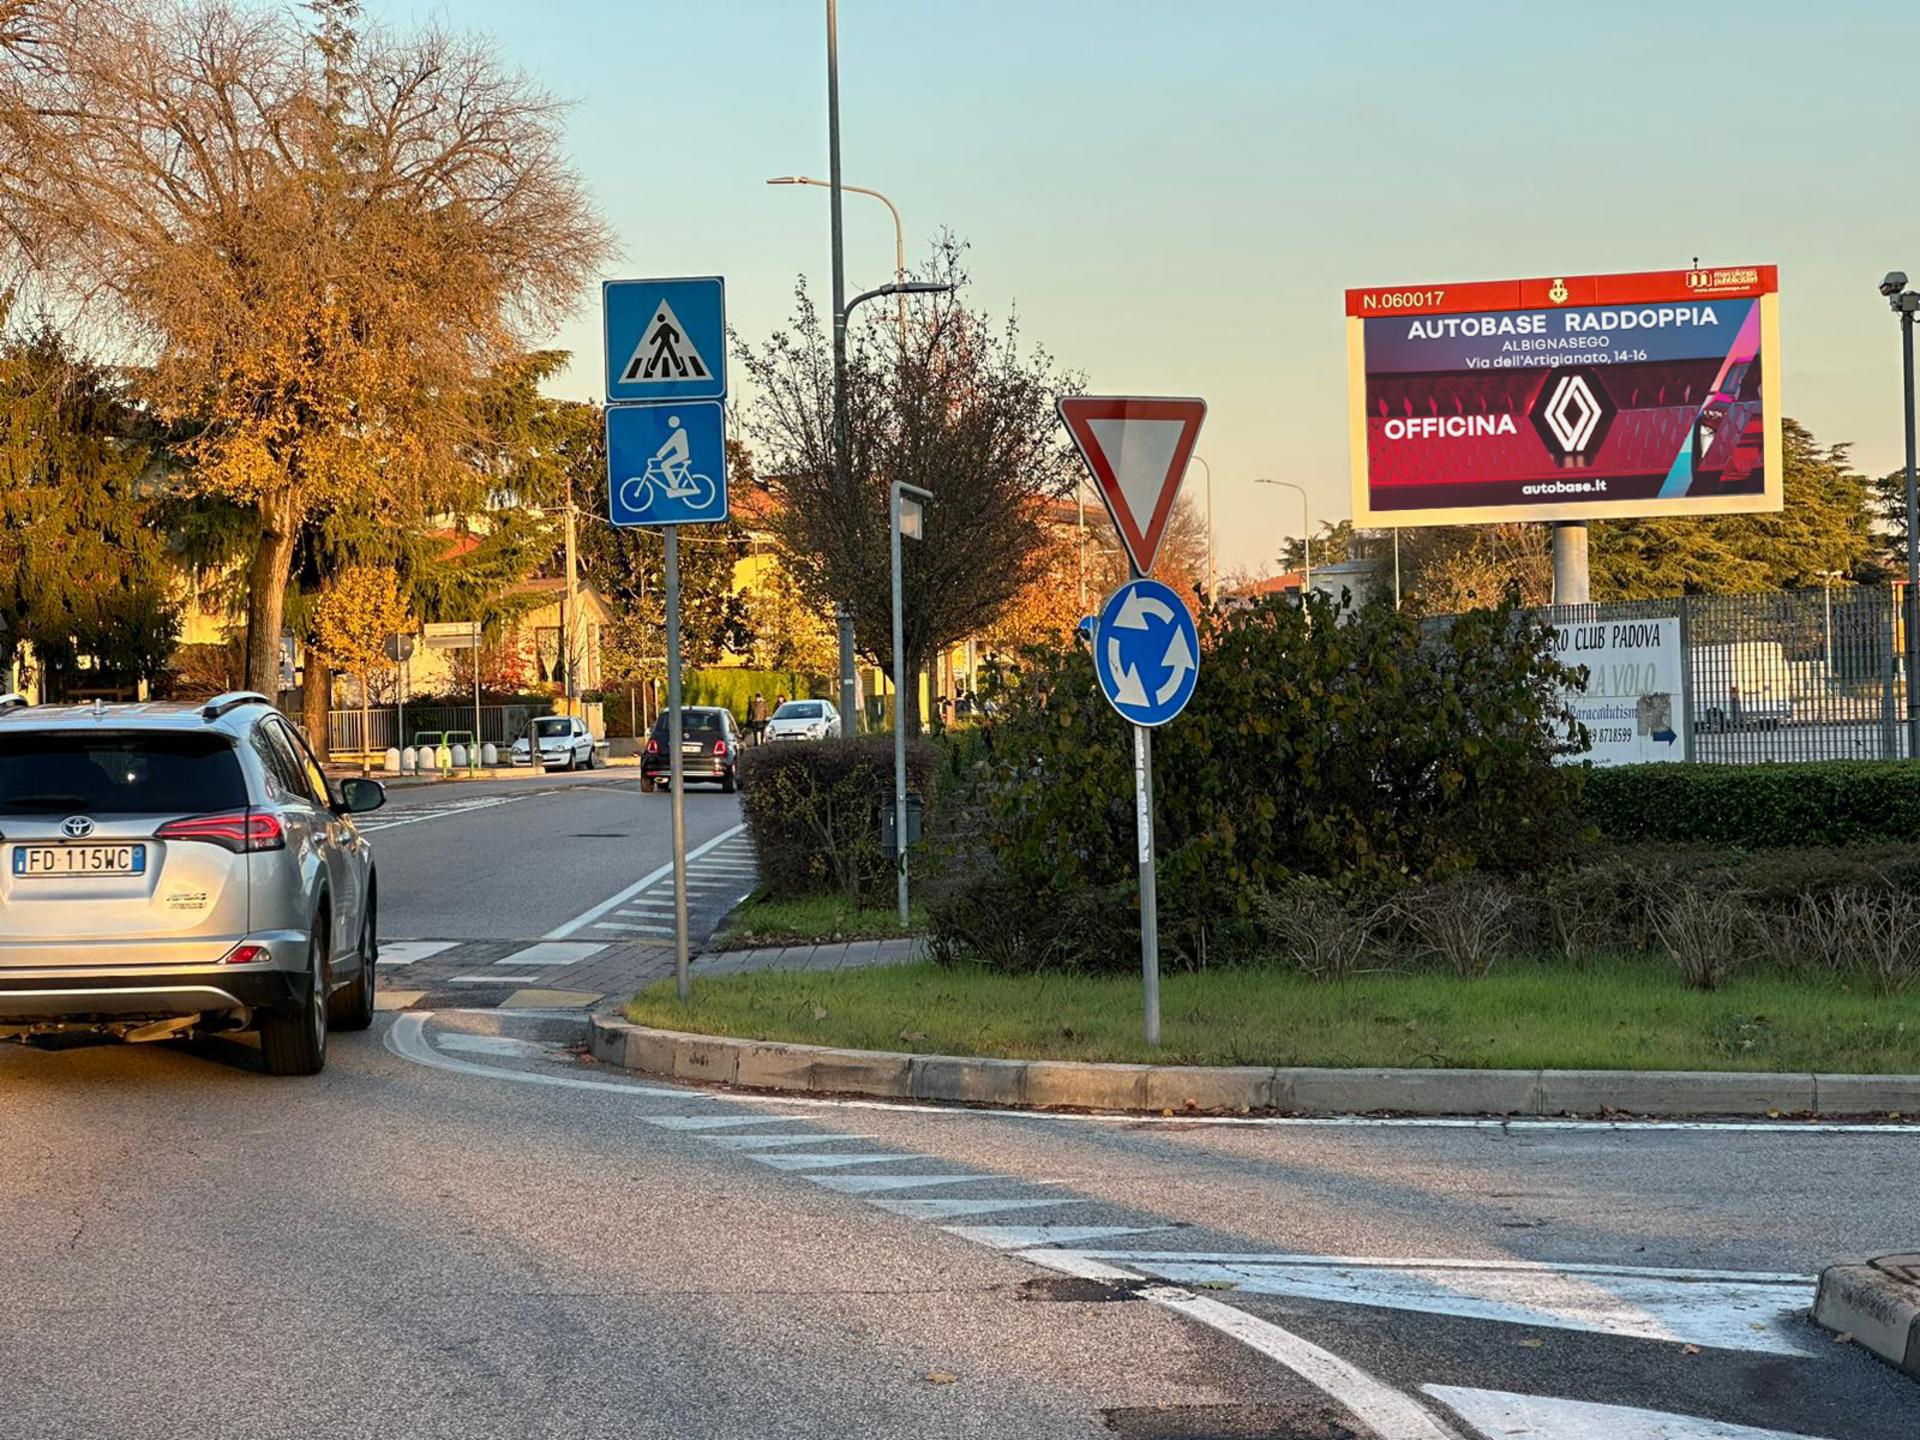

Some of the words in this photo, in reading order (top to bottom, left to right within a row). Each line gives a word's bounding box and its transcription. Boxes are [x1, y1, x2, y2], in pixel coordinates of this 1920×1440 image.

[1363, 291, 1445, 309] N.060017
[1408, 314, 1546, 340] AUTOBASE
[1565, 306, 1718, 332] RADDOPPIA
[1502, 336, 1610, 352] ALBIGNASEGO
[1465, 357, 1490, 369] Via
[1614, 349, 1647, 363] 14-16
[1384, 414, 1517, 439] OFFICINA
[1522, 479, 1607, 495] autobase.it
[1575, 625, 1605, 651] CLUB
[1612, 624, 1661, 649] PADOVA
[1599, 727, 1632, 743] 8718599
[30, 850, 55, 871] FD
[66, 849, 129, 869] 115WC
